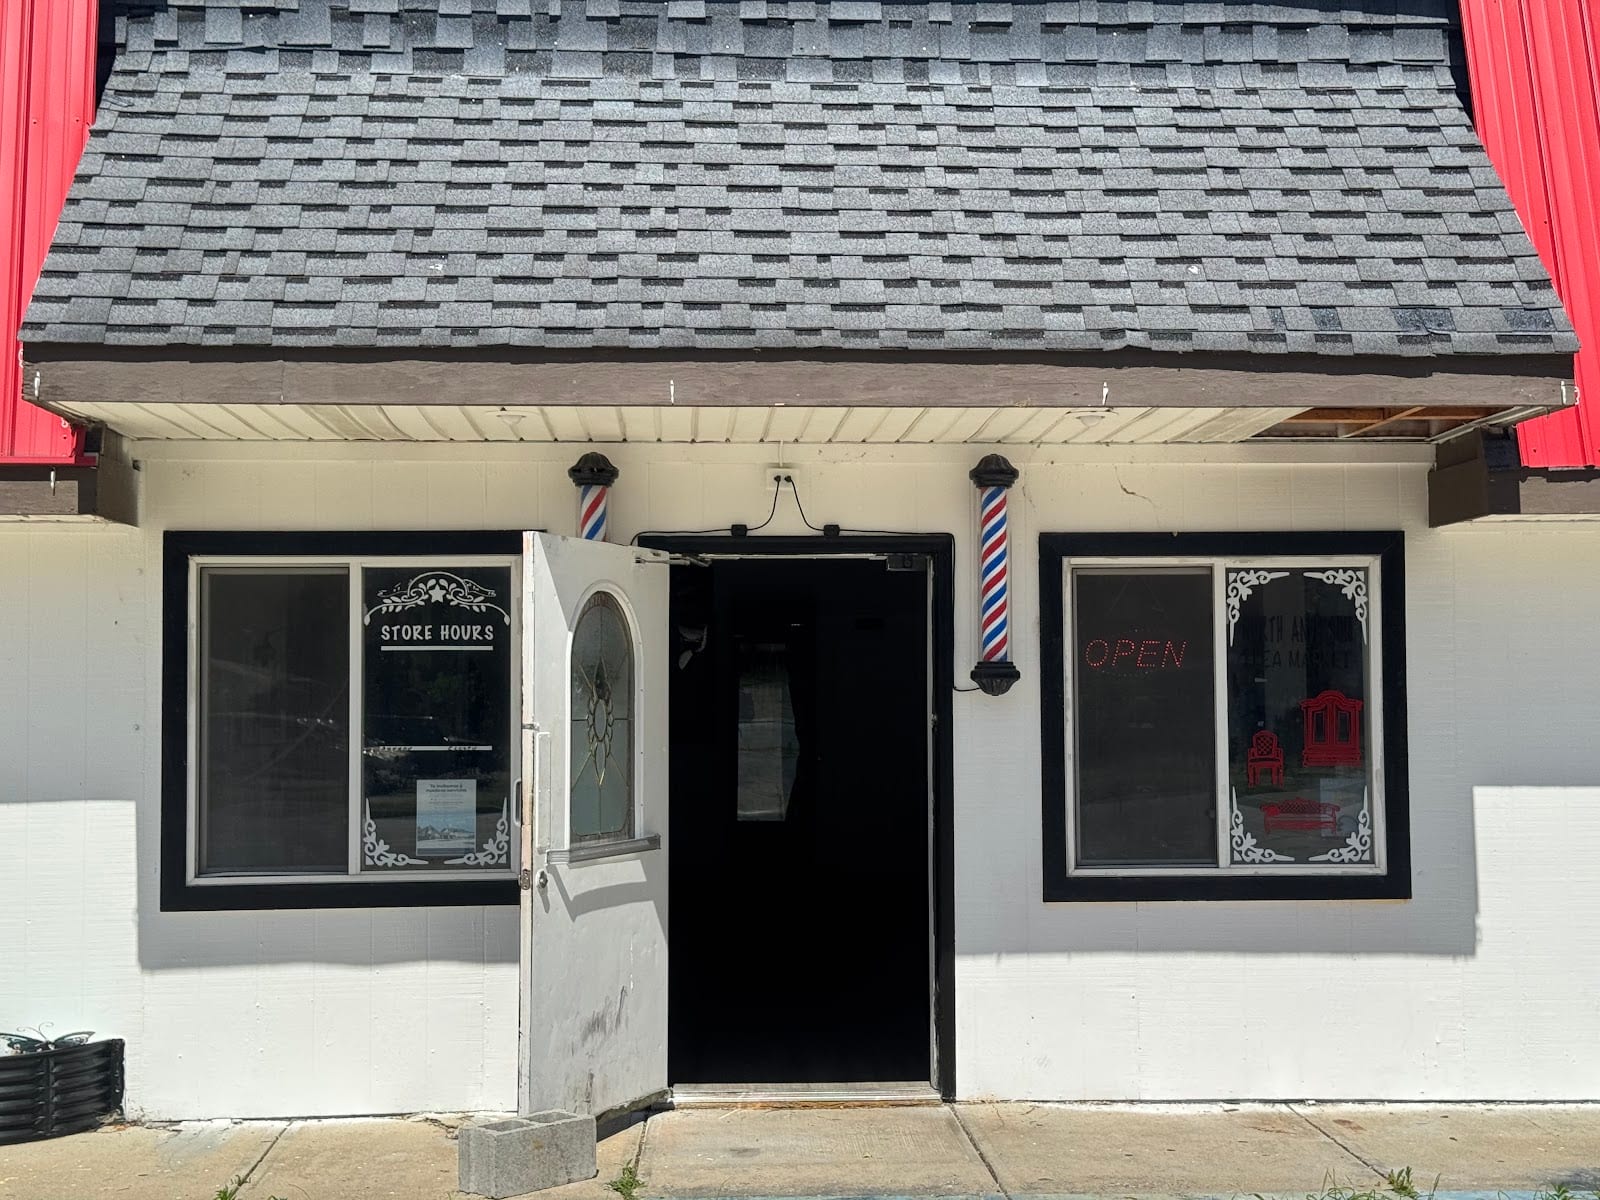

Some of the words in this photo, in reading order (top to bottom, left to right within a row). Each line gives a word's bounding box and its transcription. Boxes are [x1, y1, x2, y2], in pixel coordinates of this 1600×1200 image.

[381, 624, 433, 641] STORE
[440, 624, 494, 641] HOURS
[1085, 639, 1188, 668] OPEN
